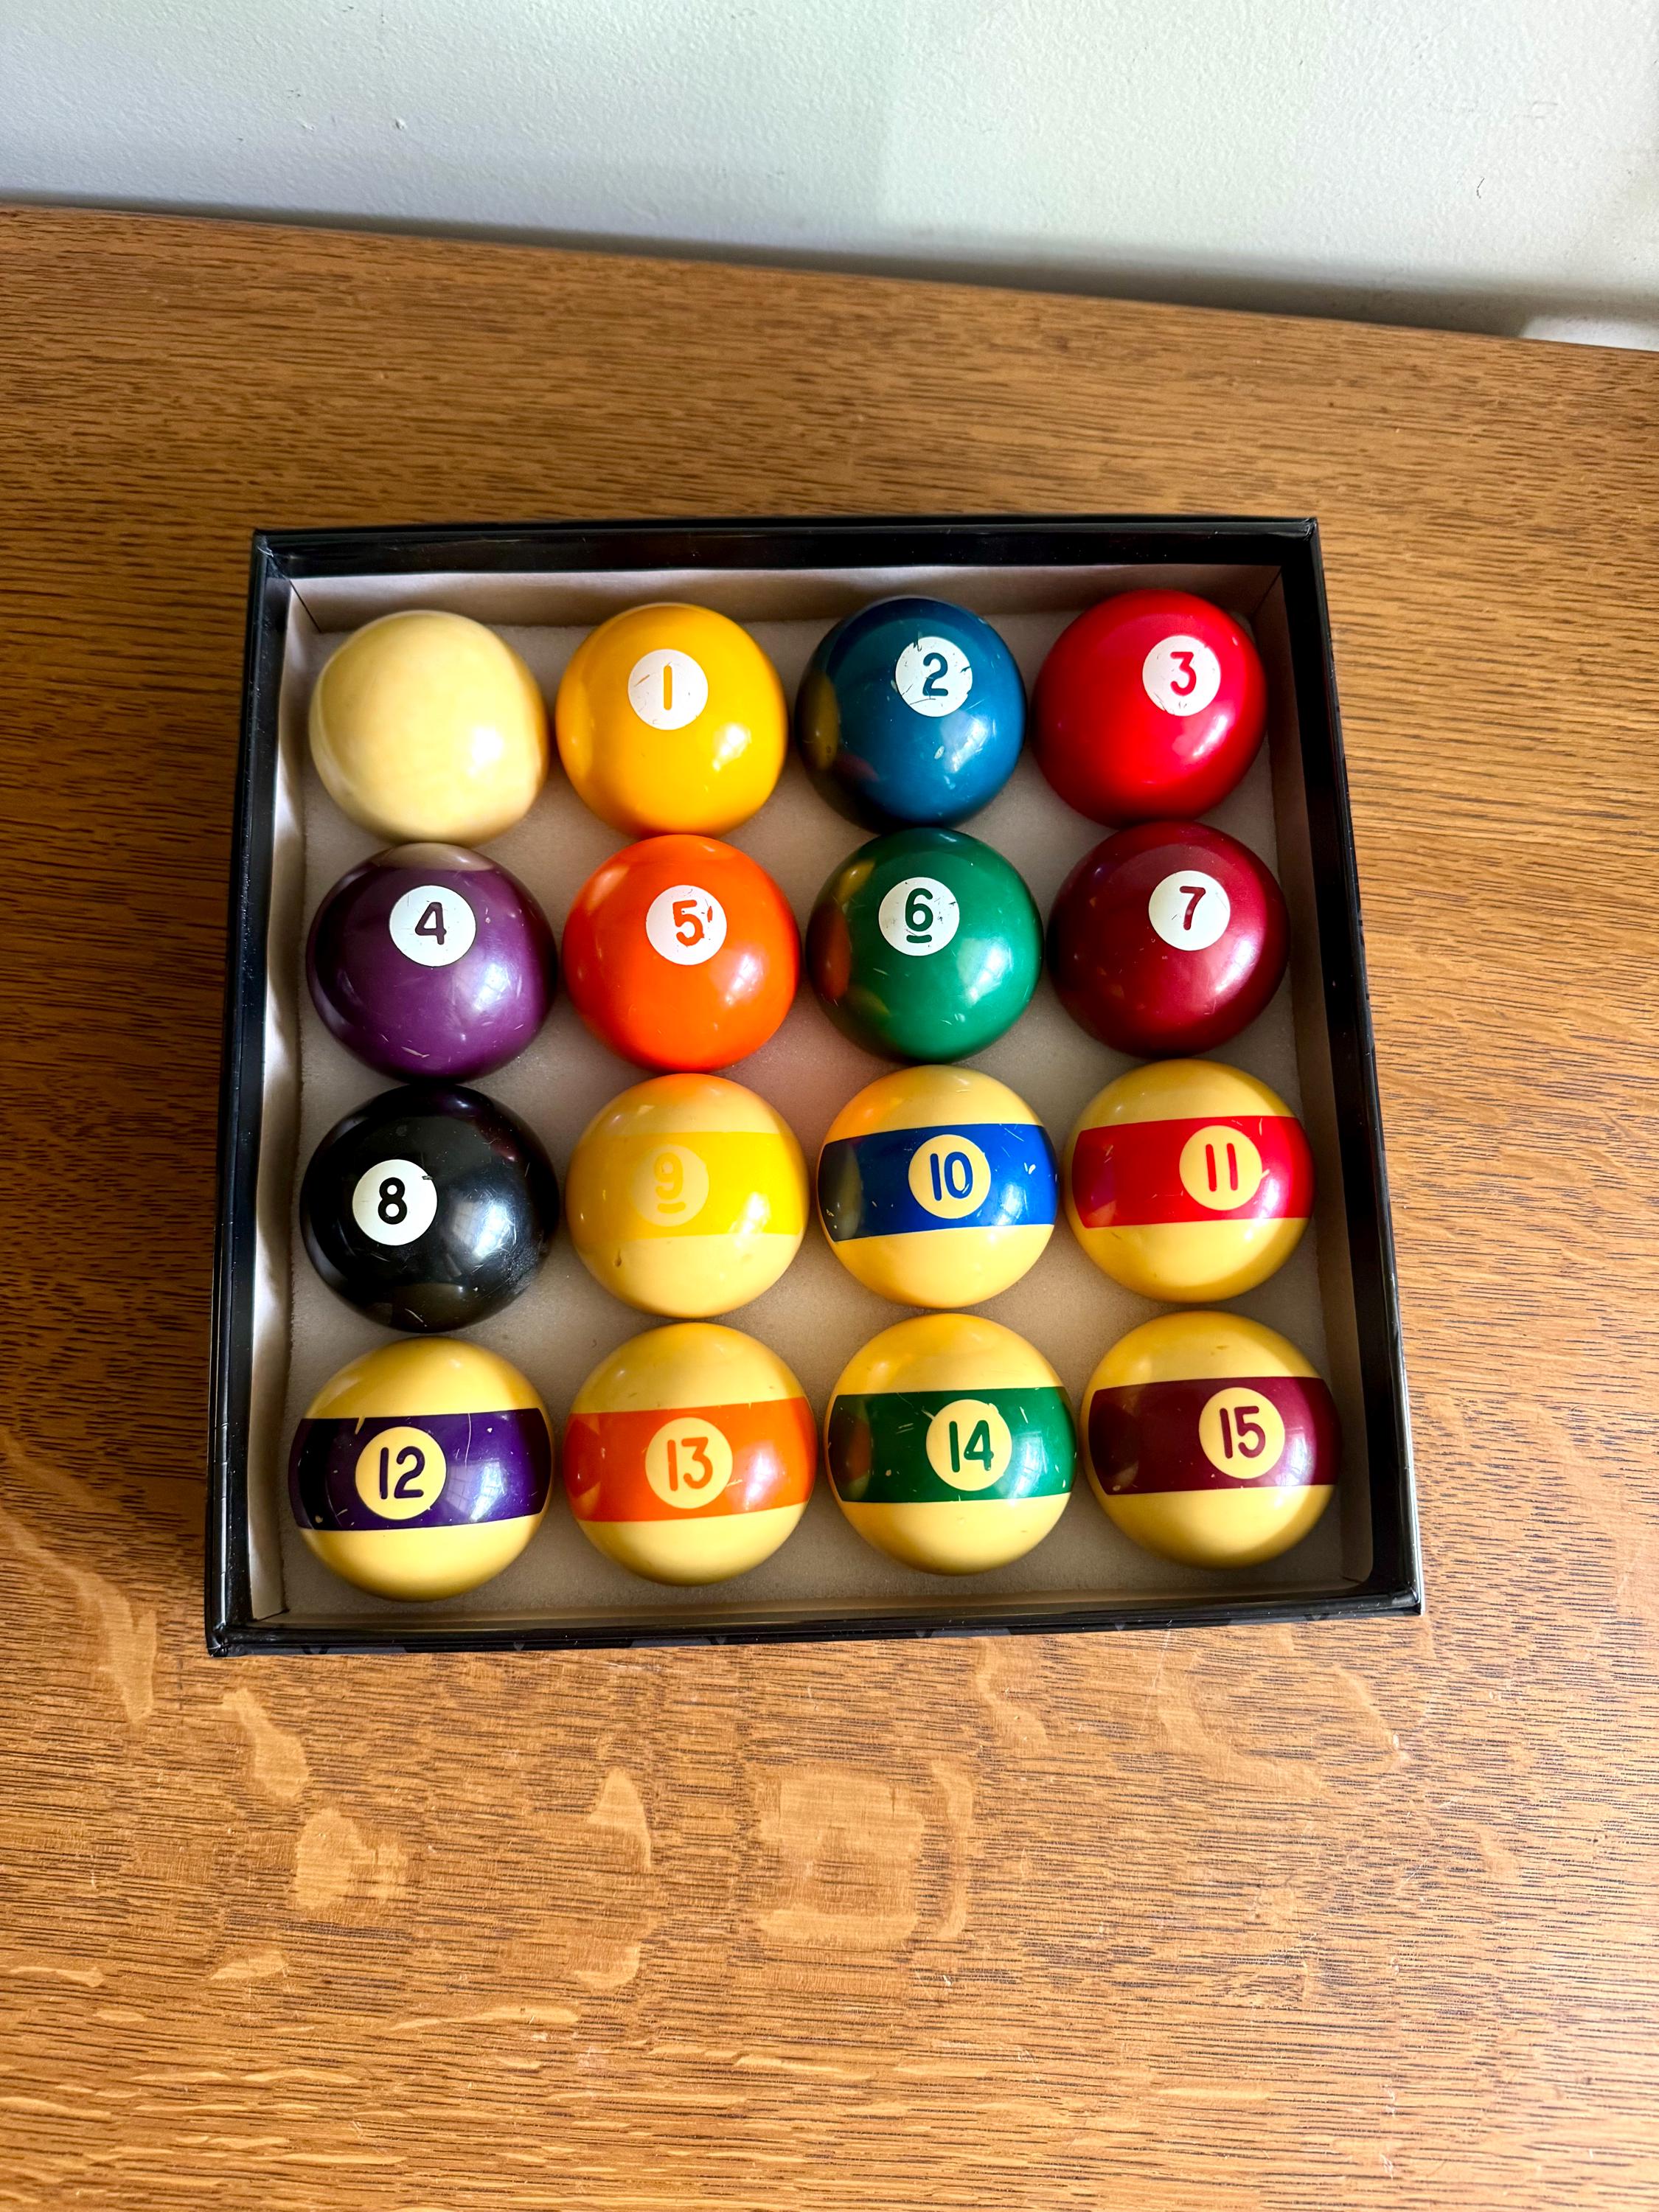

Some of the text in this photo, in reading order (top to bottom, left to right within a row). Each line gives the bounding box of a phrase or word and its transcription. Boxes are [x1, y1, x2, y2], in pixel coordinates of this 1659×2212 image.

[664, 665, 672, 711] 1
[922, 654, 948, 696] 2
[1169, 651, 1197, 696] 3
[415, 902, 447, 945] 4
[672, 900, 703, 945] 5
[905, 888, 933, 931] 6
[1179, 886, 1206, 931] 7
[654, 1156, 683, 1200] 9
[930, 1151, 973, 1201] 10
[1206, 1143, 1237, 1192] 11
[378, 1177, 407, 1225] 8
[949, 1419, 994, 1472] 14
[1219, 1405, 1266, 1458] 15
[379, 1446, 425, 1499] 12
[667, 1436, 713, 1490] 13
